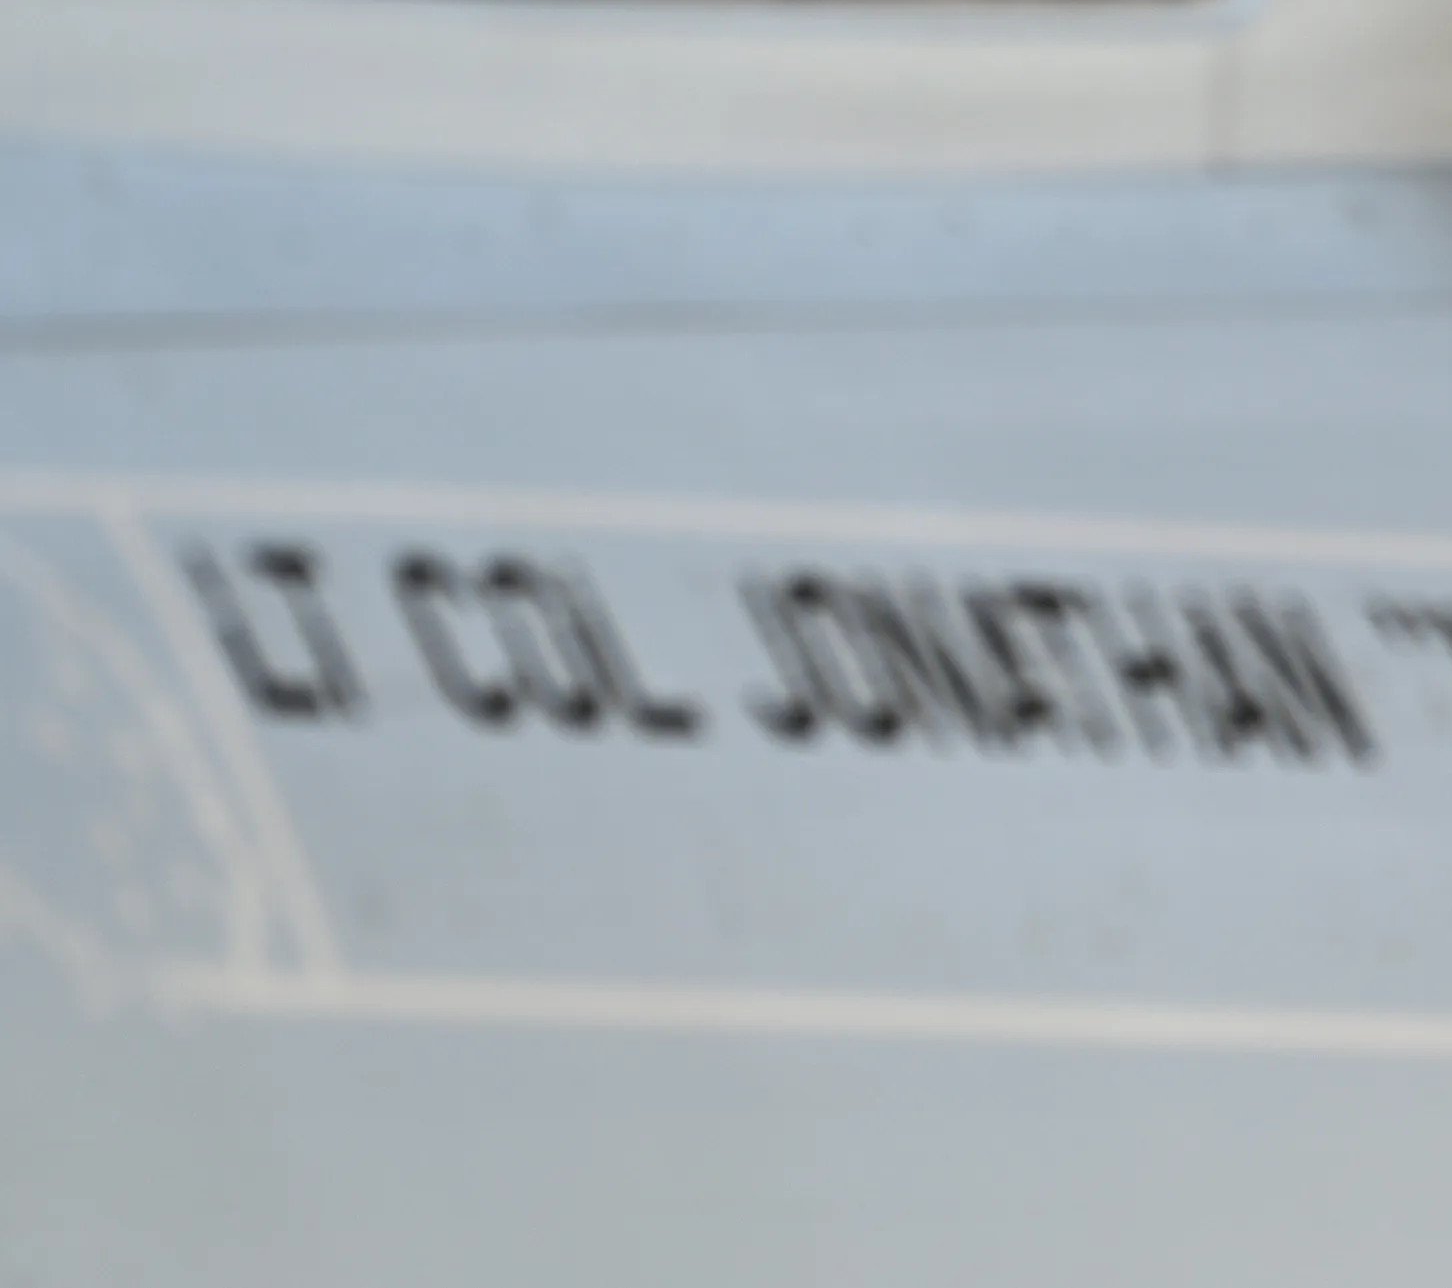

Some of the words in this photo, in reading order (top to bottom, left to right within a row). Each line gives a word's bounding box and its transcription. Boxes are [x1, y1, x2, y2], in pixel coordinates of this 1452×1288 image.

[182, 541, 370, 721] LT
[389, 544, 708, 745] COL
[736, 565, 1388, 775] JONATHAN
